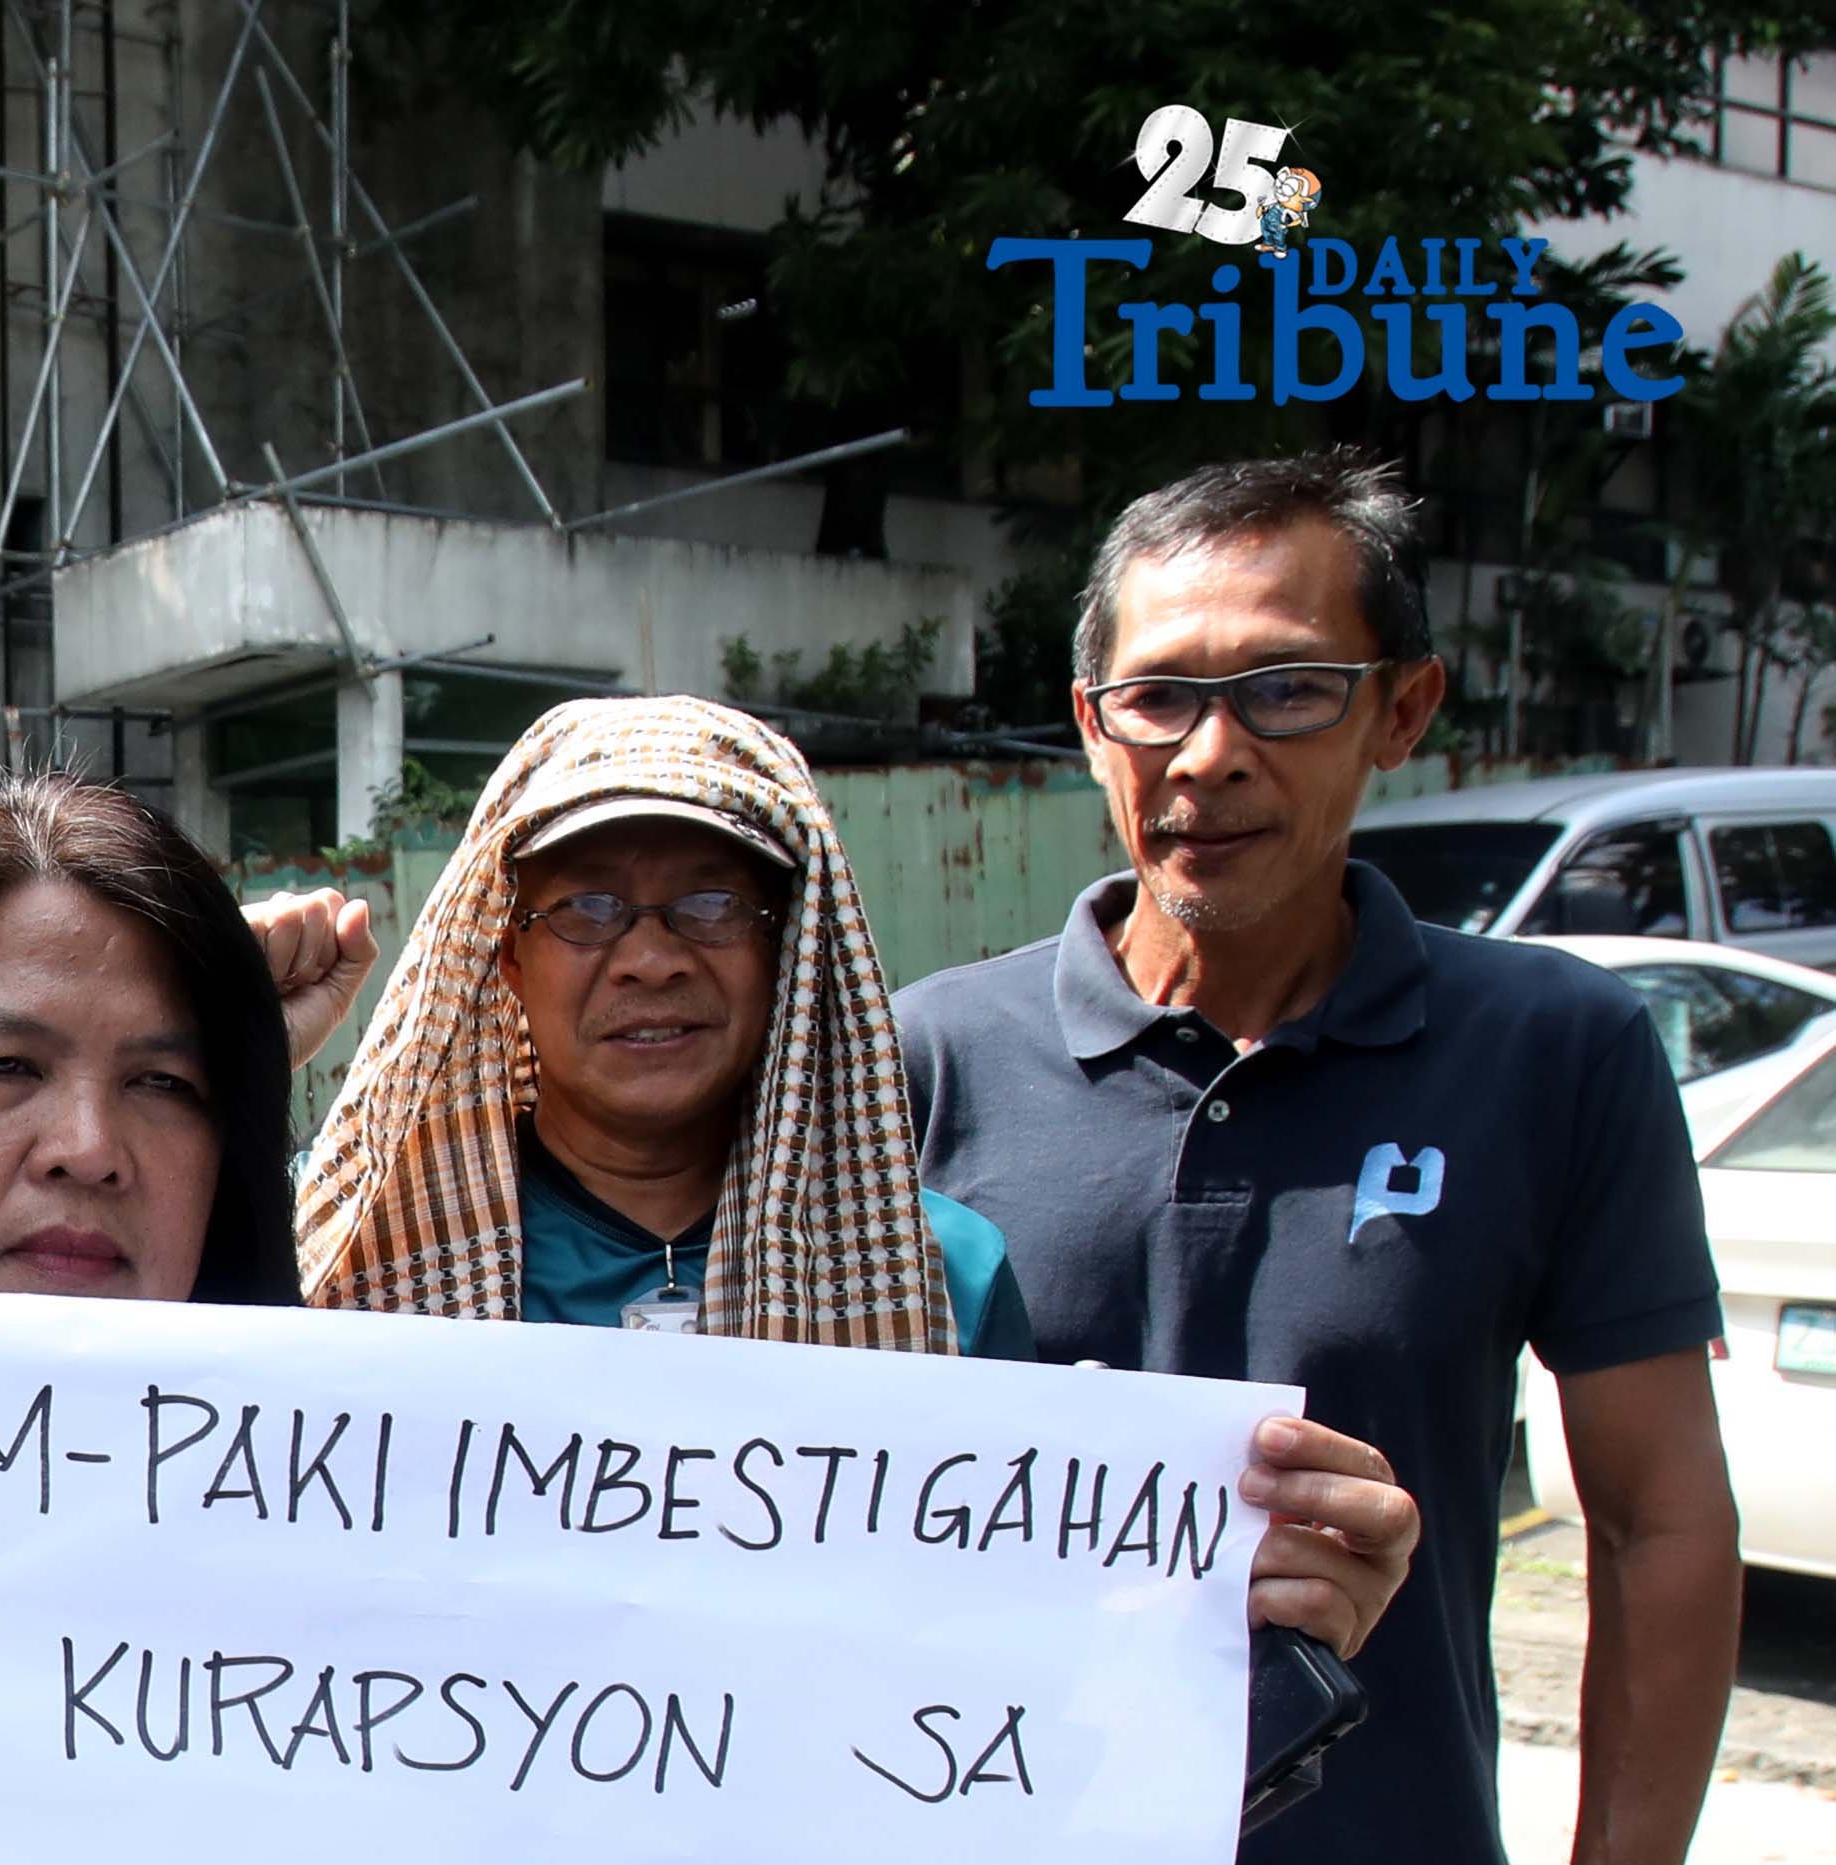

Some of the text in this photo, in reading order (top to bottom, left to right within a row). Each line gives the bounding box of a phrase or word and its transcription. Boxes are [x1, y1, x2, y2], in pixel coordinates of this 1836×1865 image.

[448, 1419, 1229, 1582] IMBESTIGAHAN
[62, 1636, 735, 1795] KURAPSYON
[852, 1702, 1035, 1803] SA
